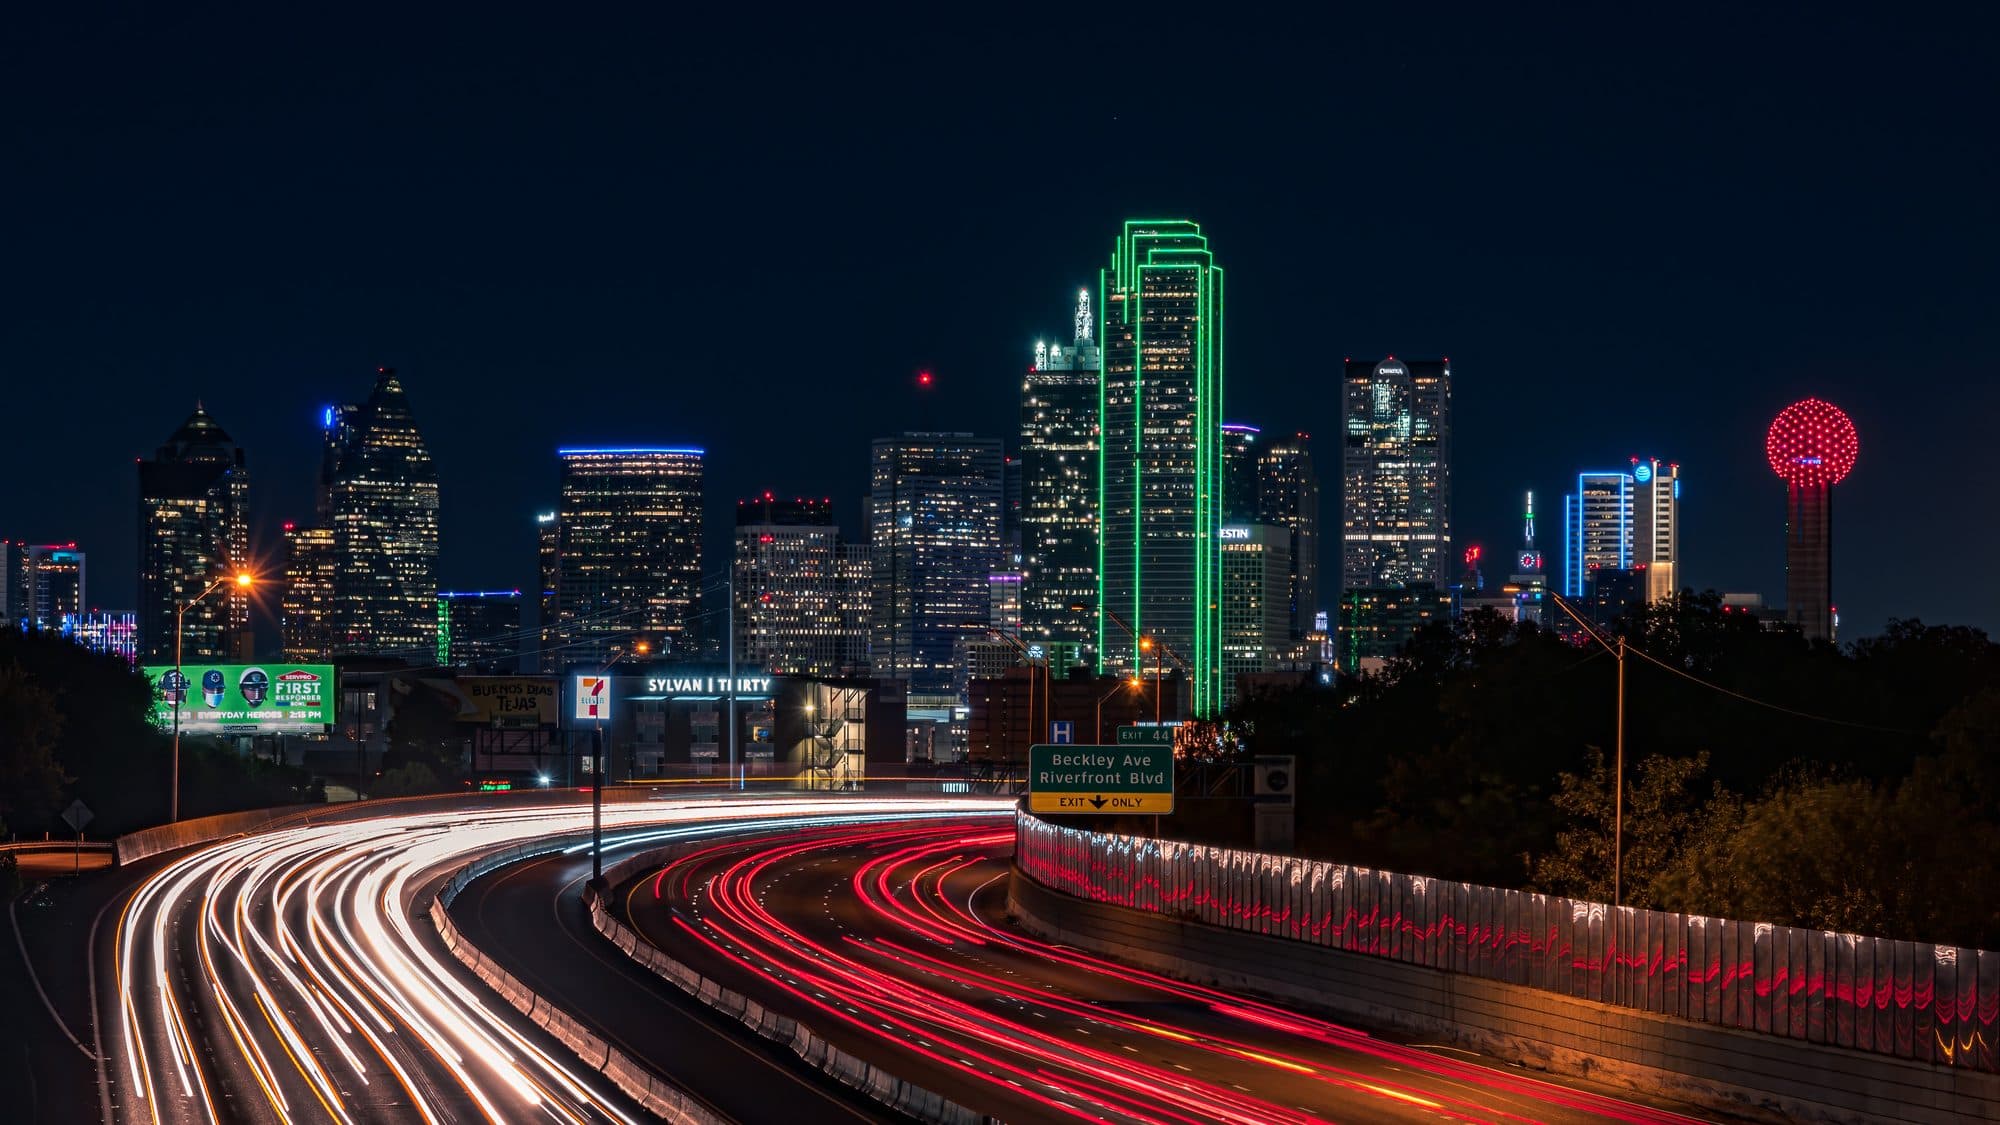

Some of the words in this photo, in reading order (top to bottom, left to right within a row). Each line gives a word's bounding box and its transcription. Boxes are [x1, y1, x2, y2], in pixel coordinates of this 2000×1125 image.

[1219, 528, 1248, 538] ESTIN
[472, 683, 523, 697] BUENOS
[648, 679, 702, 692] SYLVAN
[496, 695, 537, 712] TEJAS
[583, 678, 604, 716] 7
[197, 711, 244, 720] EVERYDAY
[247, 711, 282, 720] HEROES
[308, 711, 322, 719] PM
[1053, 723, 1071, 743] H
[1122, 731, 1142, 740] EXIT
[1152, 730, 1170, 741] 44
[1052, 754, 1115, 769] Beckley
[1123, 755, 1152, 767] Ave
[1040, 771, 1121, 784] Riverfront
[1130, 772, 1164, 785] Blvd
[1060, 798, 1085, 807] EXIT
[1112, 798, 1142, 808] ONLY
